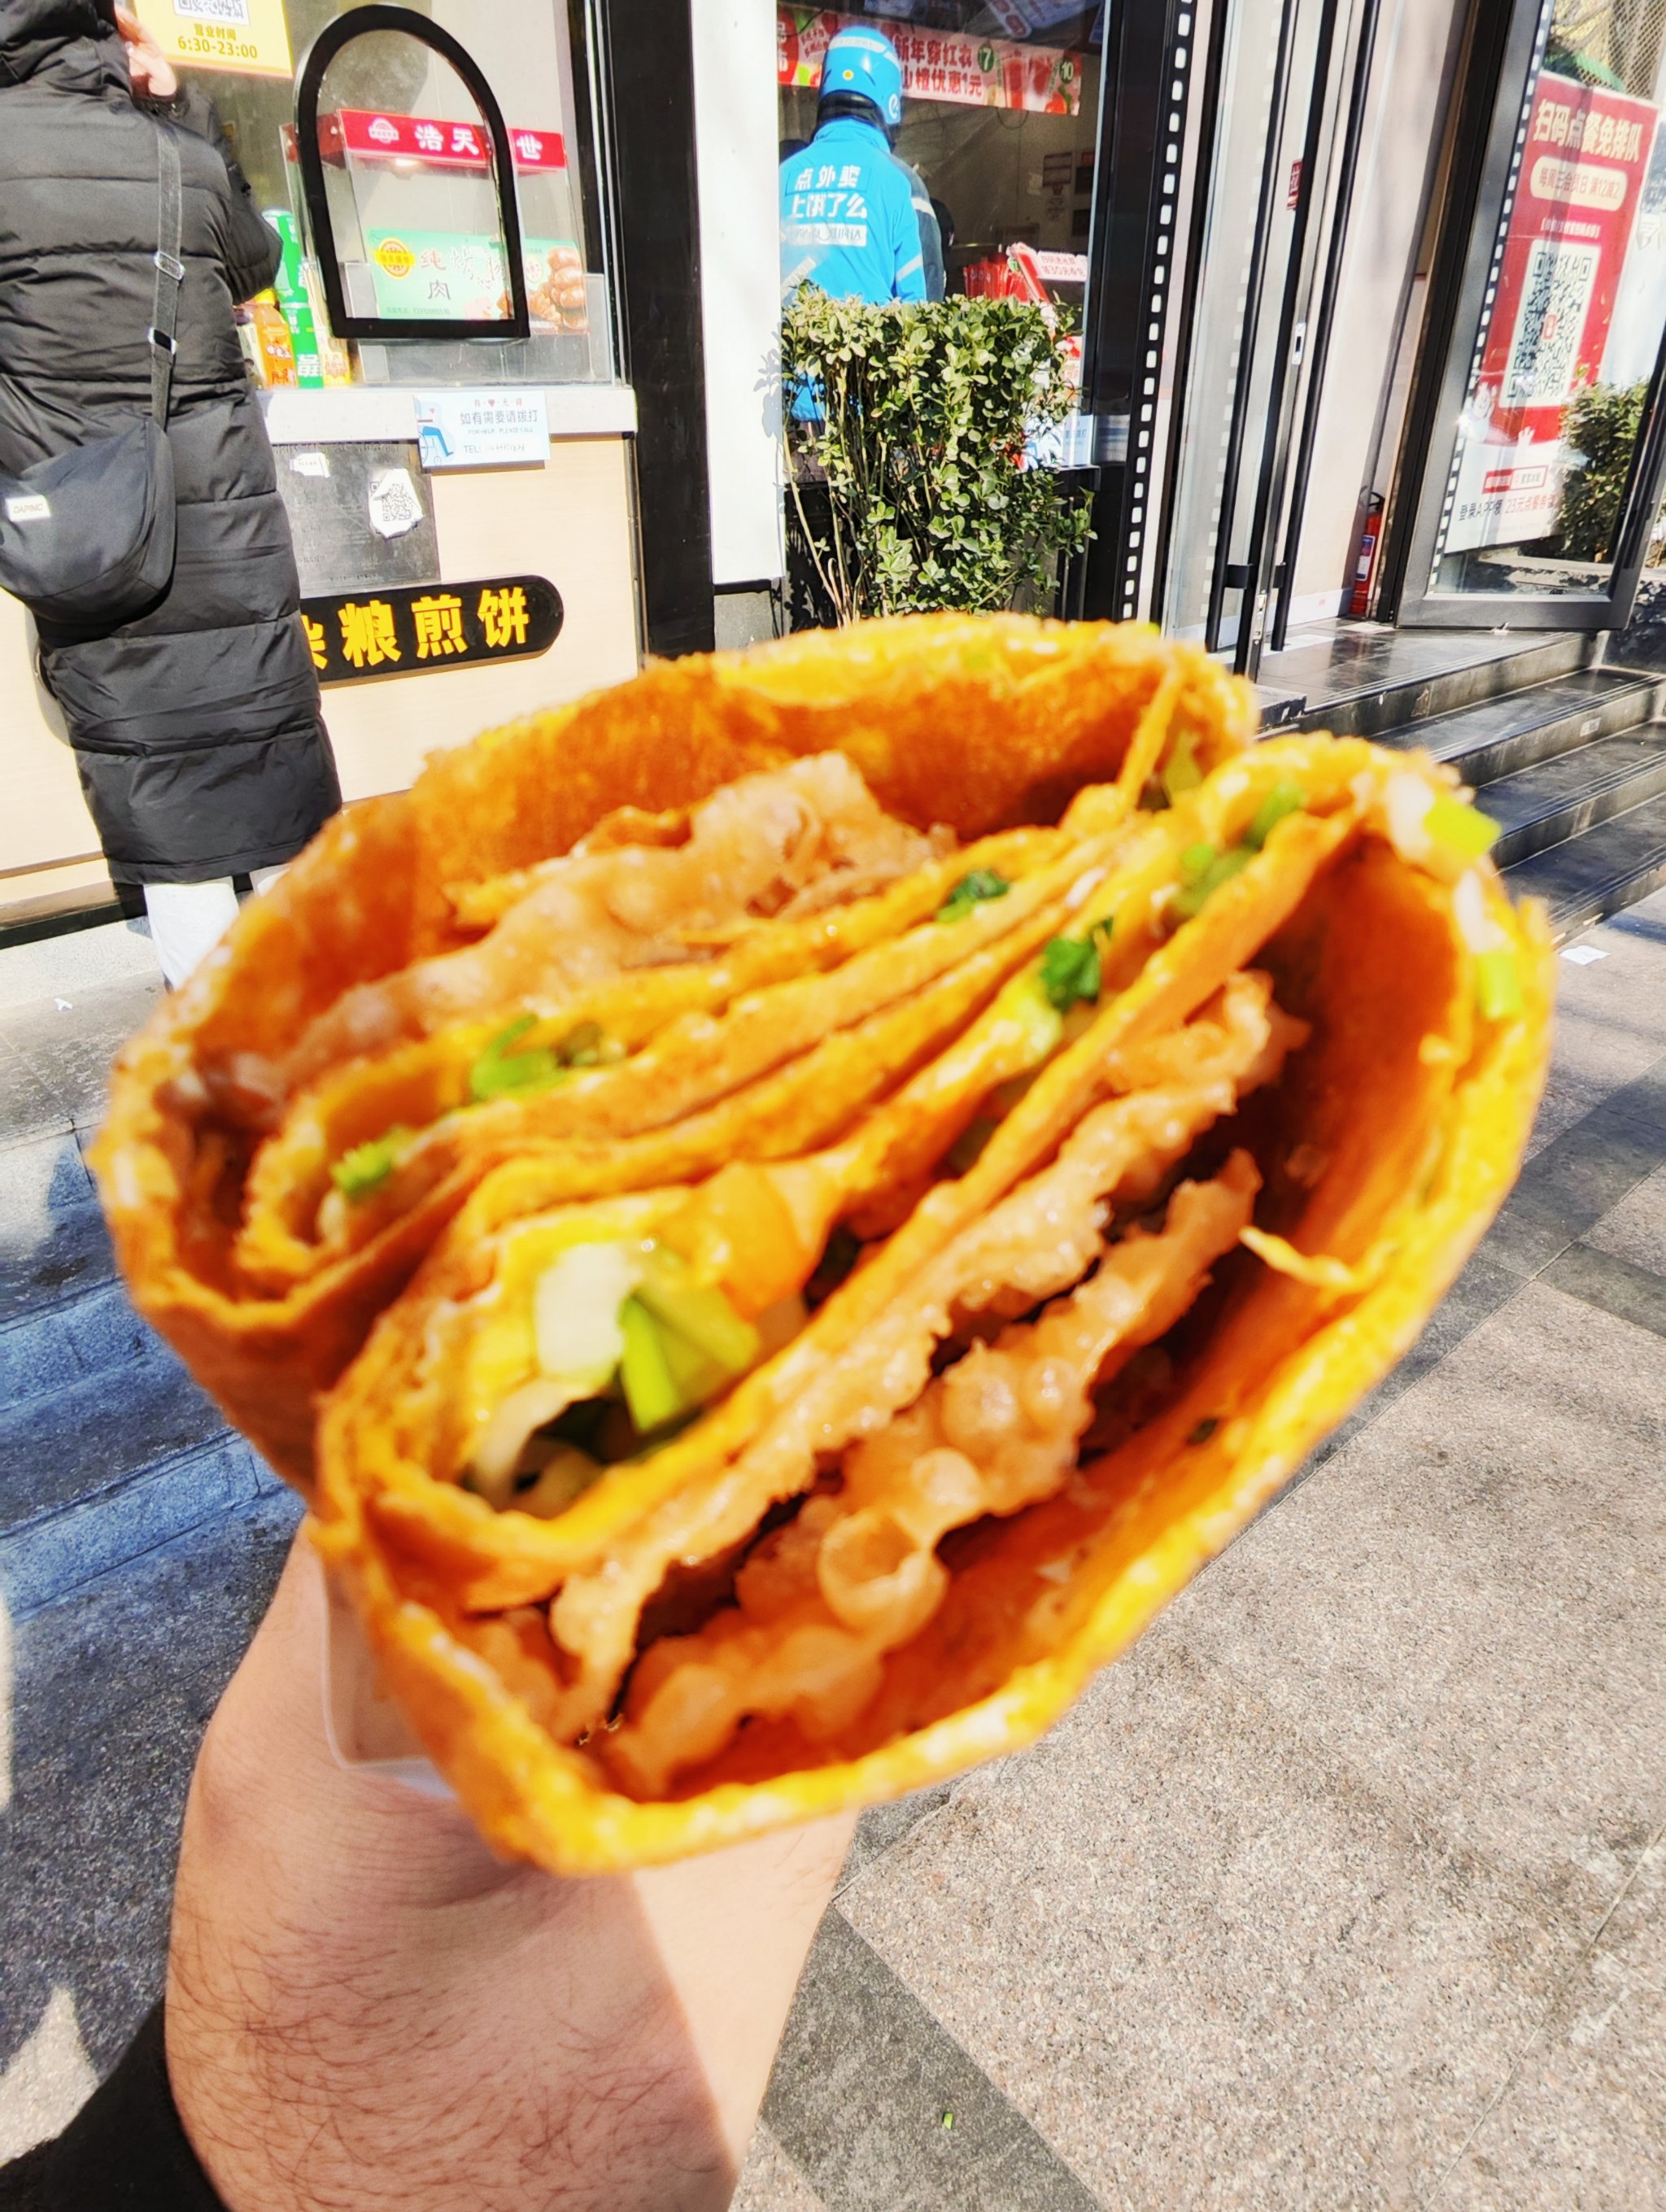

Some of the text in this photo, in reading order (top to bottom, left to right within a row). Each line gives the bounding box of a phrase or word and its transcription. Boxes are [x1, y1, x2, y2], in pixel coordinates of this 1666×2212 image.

[194, 24, 237, 41] 营业时间
[177, 36, 258, 59] 6:30-23:00
[1061, 62, 1074, 79] 10
[1533, 98, 1643, 163] 扫码点餐免排队
[791, 193, 868, 219] 上饿了么
[427, 278, 451, 300] 肉
[460, 409, 539, 425] 如有需要请拨打
